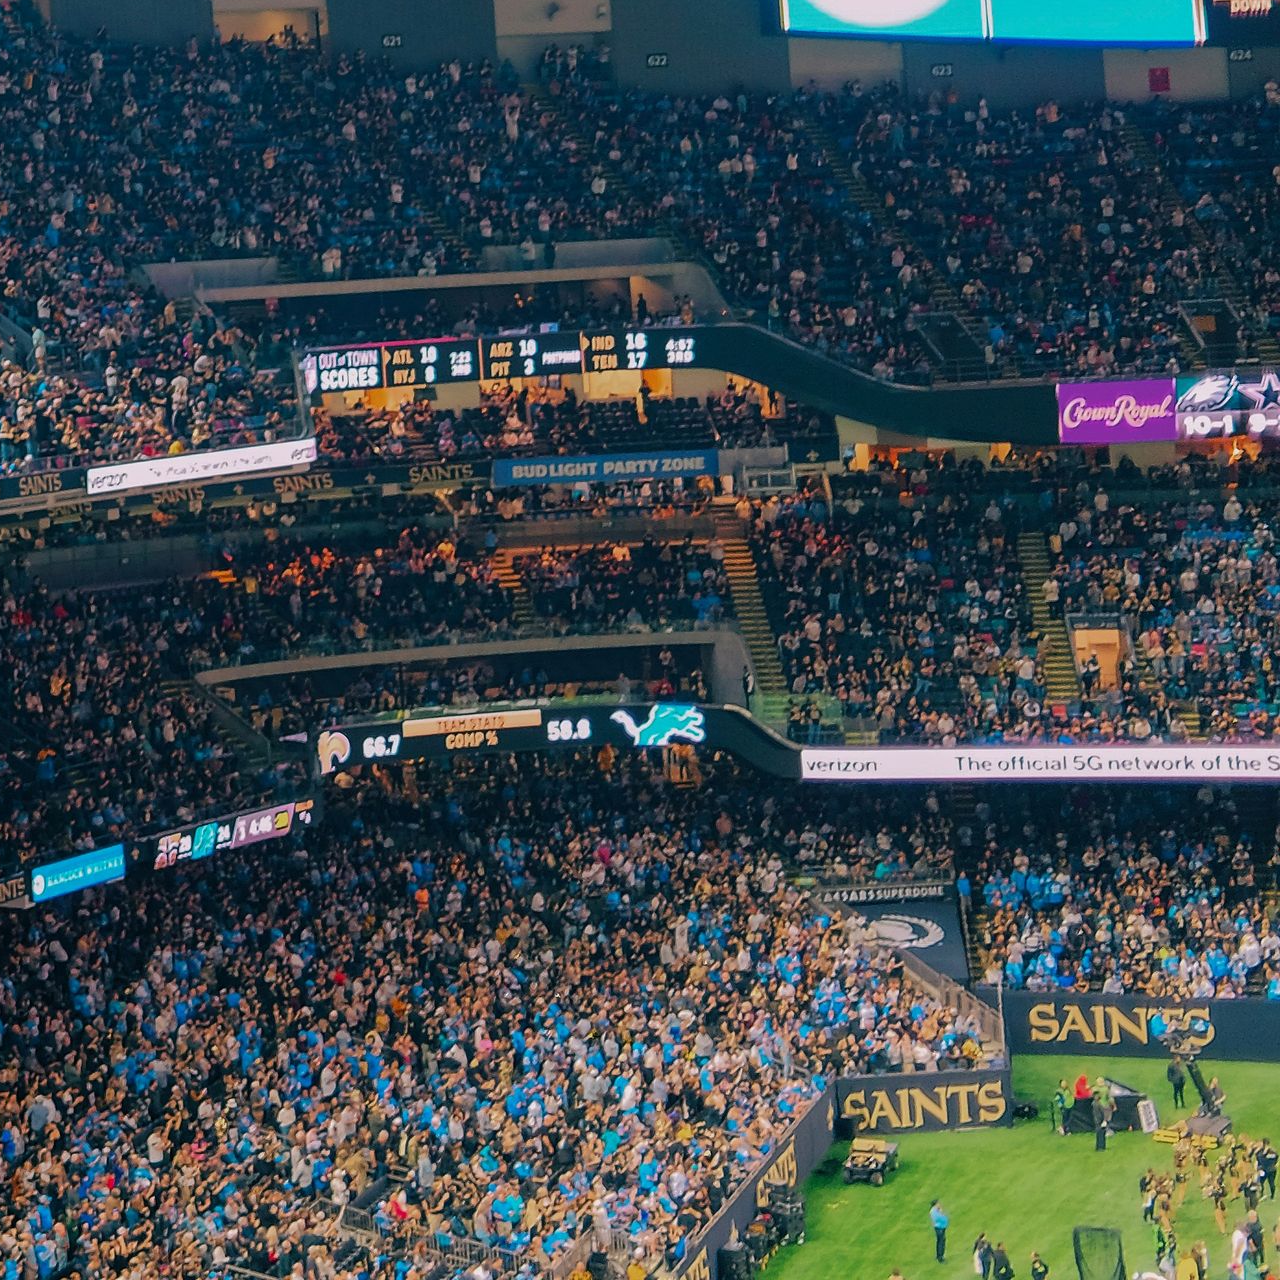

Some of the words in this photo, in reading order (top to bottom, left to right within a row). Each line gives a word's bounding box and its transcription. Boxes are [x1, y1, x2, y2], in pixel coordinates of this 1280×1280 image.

[346, 349, 378, 367] TOWN
[626, 351, 647, 369] 17
[320, 366, 379, 390] SCORES
[1063, 396, 1117, 428] Crown
[1183, 414, 1234, 435] 10-1
[409, 464, 474, 484] SAINTS
[512, 464, 548, 479] BUD
[549, 461, 596, 477] LIGHT
[603, 458, 660, 475] PARTY
[661, 456, 705, 473] ZONE
[20, 473, 62, 497] SAINTS
[273, 473, 334, 494] SAINTS
[445, 732, 485, 749] COMP
[806, 755, 878, 773] verizon
[955, 755, 992, 772] The
[997, 754, 1067, 772] official
[1072, 755, 1103, 772] 5G
[1107, 754, 1195, 772] network
[1201, 754, 1223, 772] of
[1226, 754, 1263, 772] the
[843, 1080, 1007, 1130] SAINTS
